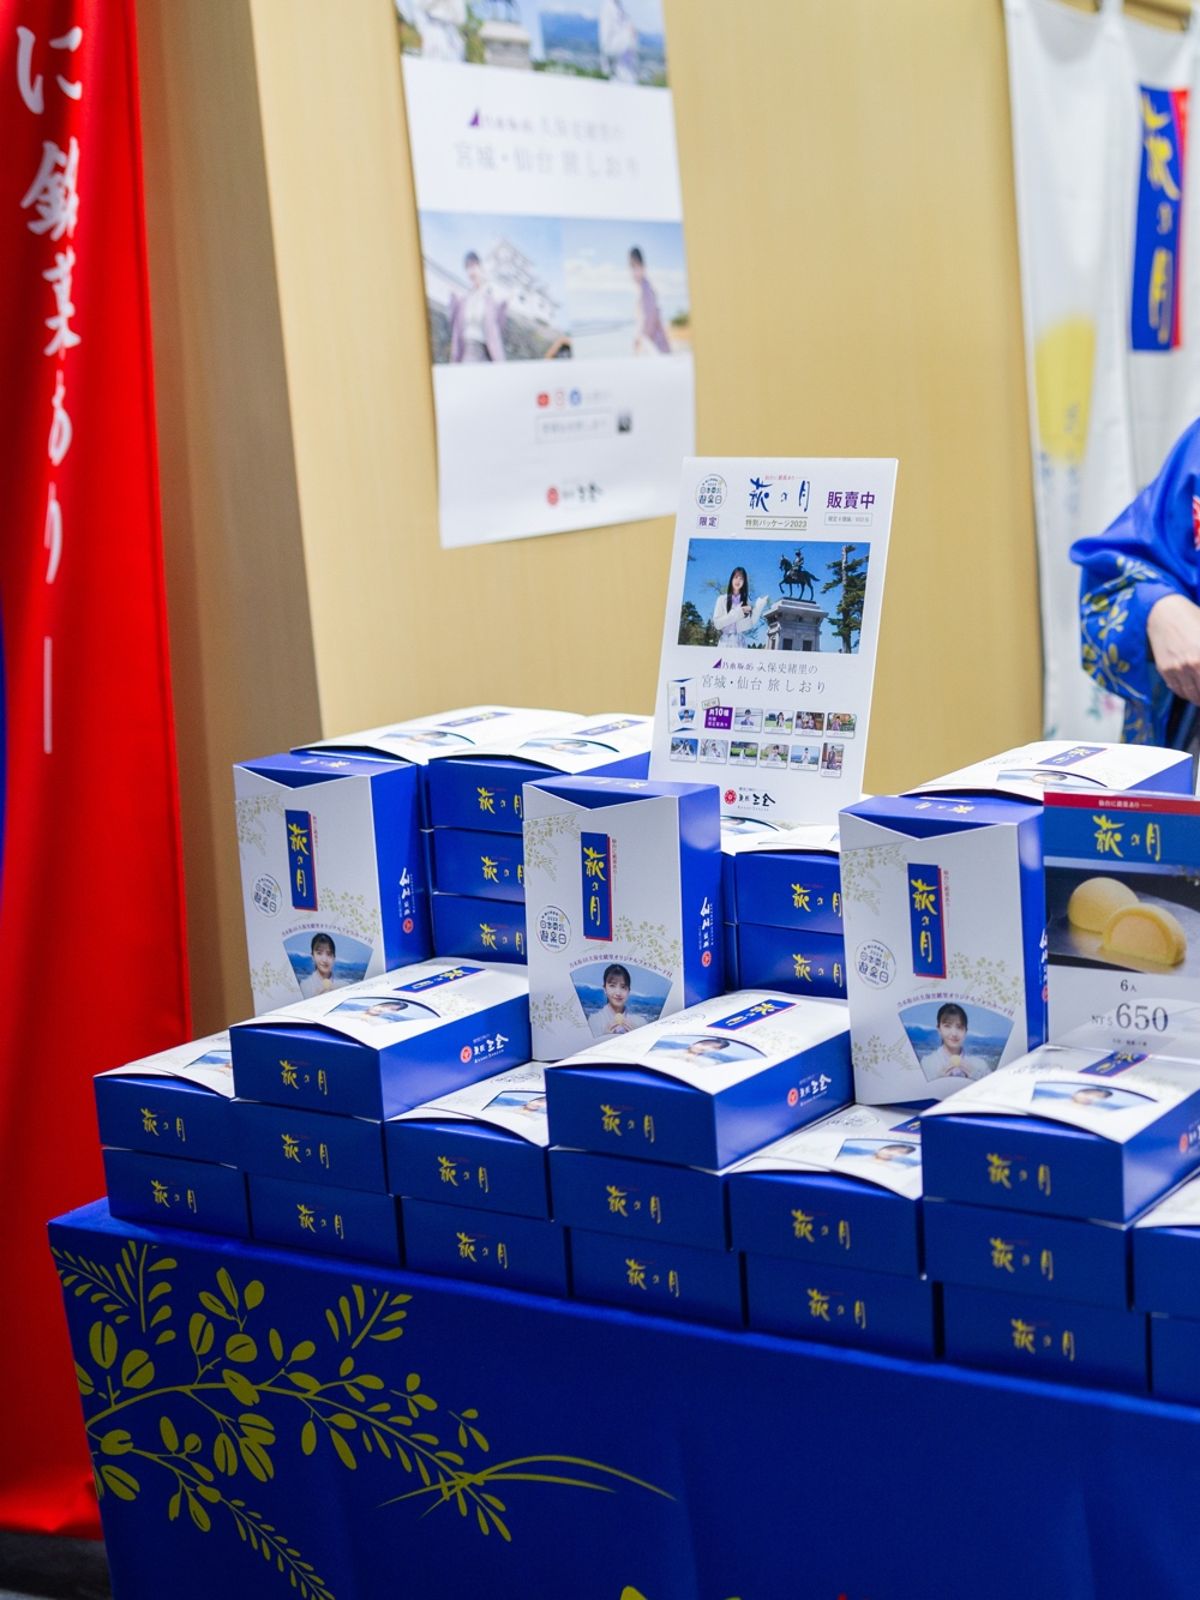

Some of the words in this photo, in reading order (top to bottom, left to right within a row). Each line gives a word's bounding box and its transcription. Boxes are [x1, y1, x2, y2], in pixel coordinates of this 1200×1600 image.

[749, 477, 811, 513] 萩の月
[827, 491, 876, 510] 販賣中
[699, 516, 718, 527] 限定
[745, 518, 808, 529] 特別パッケージ2023
[701, 675, 763, 692] 宮城・仙台
[477, 786, 523, 820] 萩の月
[1092, 813, 1162, 862] 萩の月
[288, 823, 310, 897] 萩の月
[583, 846, 607, 926] 萩の月
[791, 883, 843, 918] 萩の月
[910, 878, 938, 964] 萩の月
[792, 953, 844, 988] 萩の月
[1116, 1003, 1169, 1032] 650
[280, 1060, 328, 1096] 萩の月
[140, 1107, 186, 1142] 萩の月
[600, 1104, 656, 1143] 萩の月
[281, 1133, 330, 1169] 萩の月
[437, 1155, 490, 1193] 萩の月
[986, 1153, 1052, 1197] 萩の月
[151, 1180, 198, 1214] 萩の月
[606, 1185, 662, 1225] 萩の月
[297, 1204, 344, 1239] 萩の月
[791, 1209, 852, 1250] 萩の月
[456, 1231, 508, 1269] 萩の月
[990, 1238, 1055, 1281] 萩の月
[625, 1259, 680, 1298] 萩の月
[808, 1288, 867, 1330] 萩の月
[1011, 1319, 1076, 1361] 萩の月
